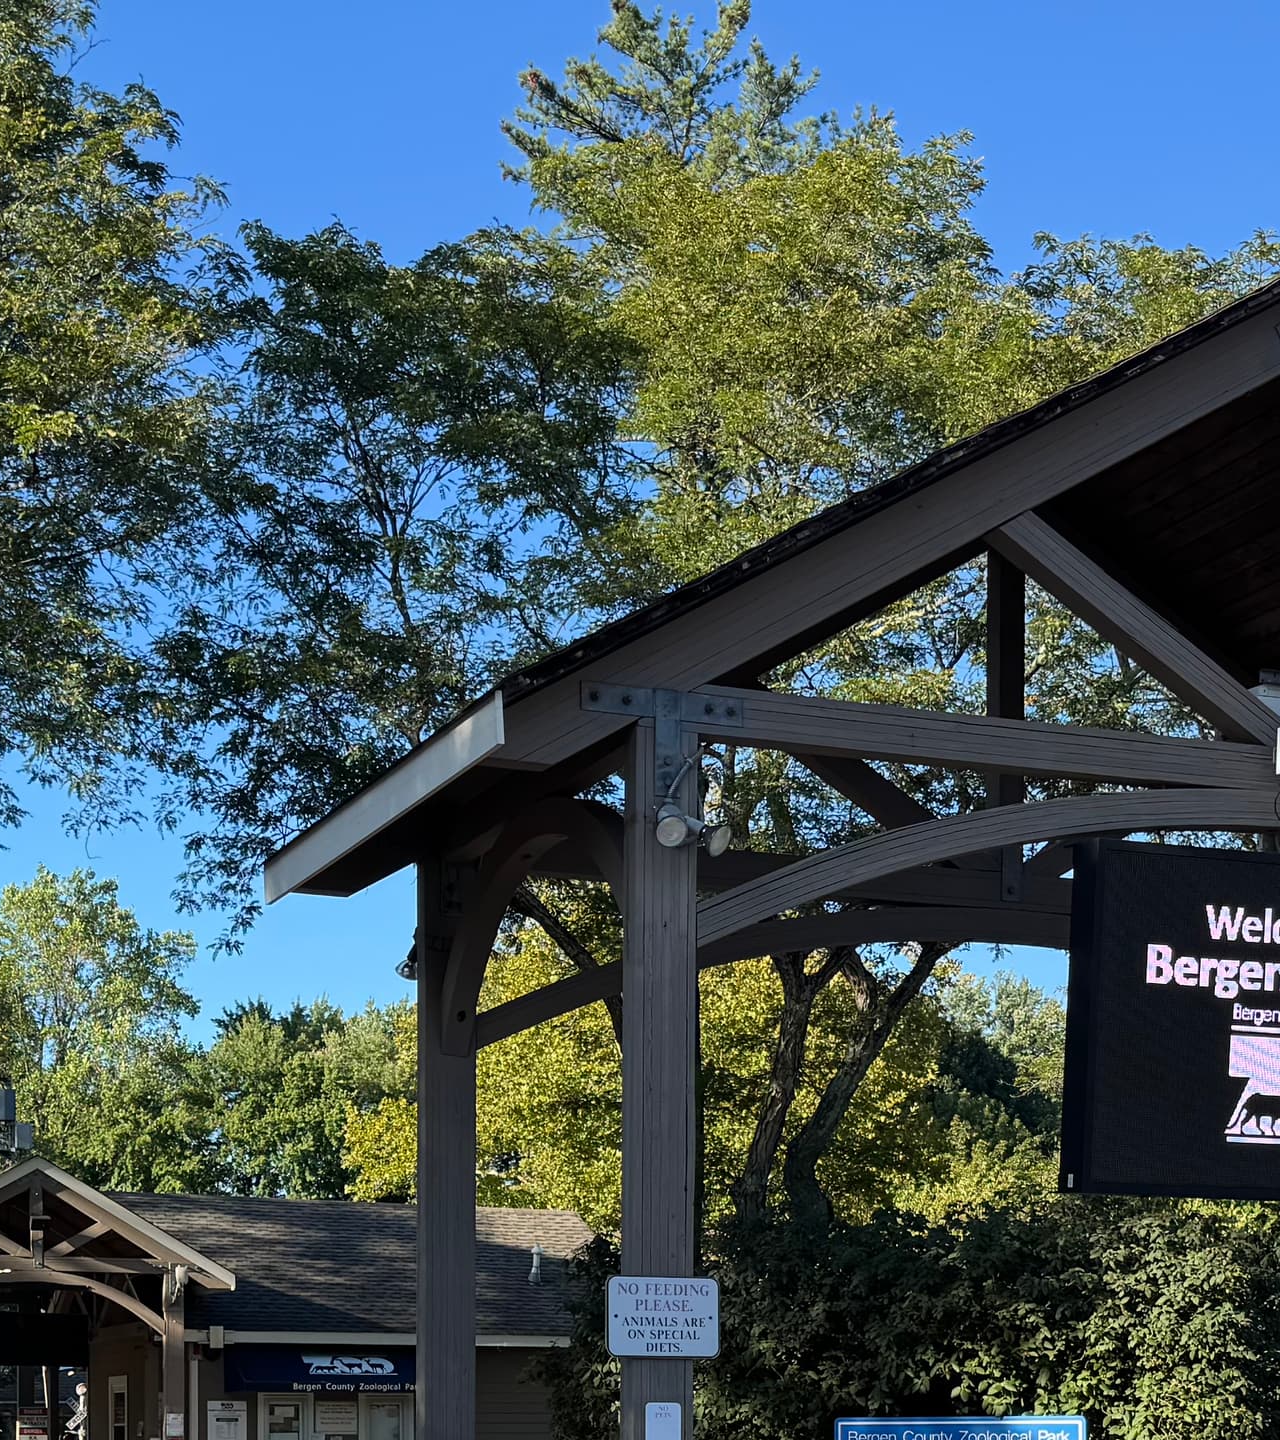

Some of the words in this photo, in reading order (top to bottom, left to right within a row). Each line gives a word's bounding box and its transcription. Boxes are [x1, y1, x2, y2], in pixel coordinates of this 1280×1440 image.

[1232, 1002, 1280, 1026] Bergen
[617, 1282, 640, 1296] NO
[645, 1282, 710, 1297] FEEDING
[635, 1298, 694, 1312] PLEASE.
[622, 1316, 679, 1328] ANIMALS
[682, 1316, 707, 1328] ARE
[627, 1328, 646, 1340] ON
[649, 1329, 701, 1341] SPECIAL
[646, 1341, 684, 1353] DIETS.
[293, 1382, 322, 1391] Bergen
[326, 1382, 355, 1392] County
[359, 1382, 401, 1392] Zoological
[405, 1382, 417, 1391] Pa
